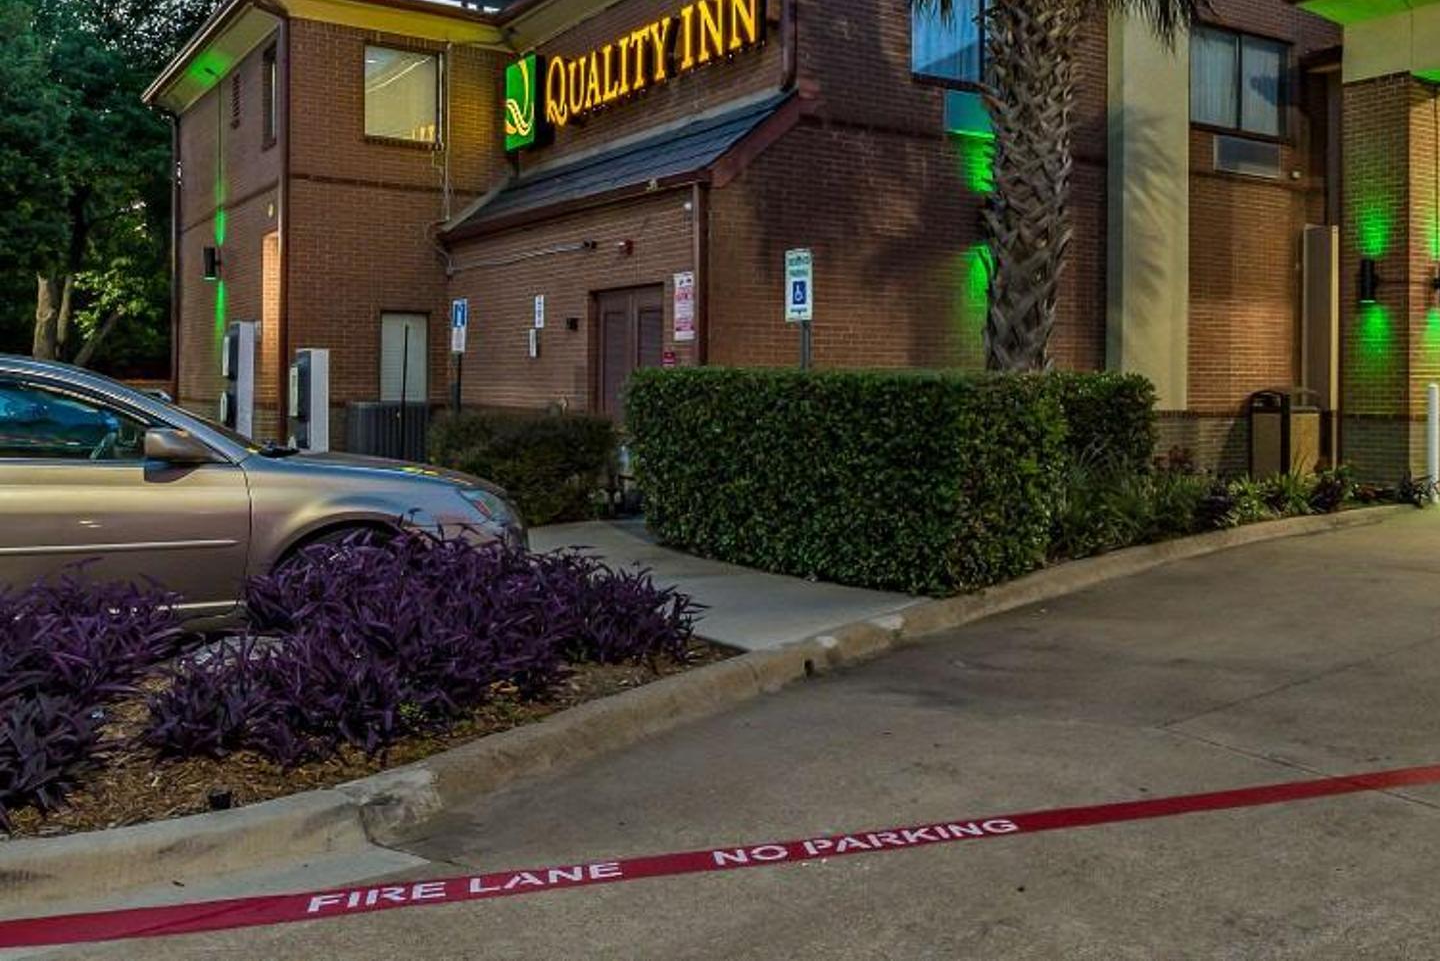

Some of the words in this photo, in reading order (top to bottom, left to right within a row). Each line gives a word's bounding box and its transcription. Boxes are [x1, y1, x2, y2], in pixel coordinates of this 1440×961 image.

[546, 17, 671, 126] QUALITY
[712, 844, 789, 866] NO
[802, 819, 1019, 856] PARKING
[307, 881, 447, 914] FIRE
[468, 862, 624, 894] LANE
